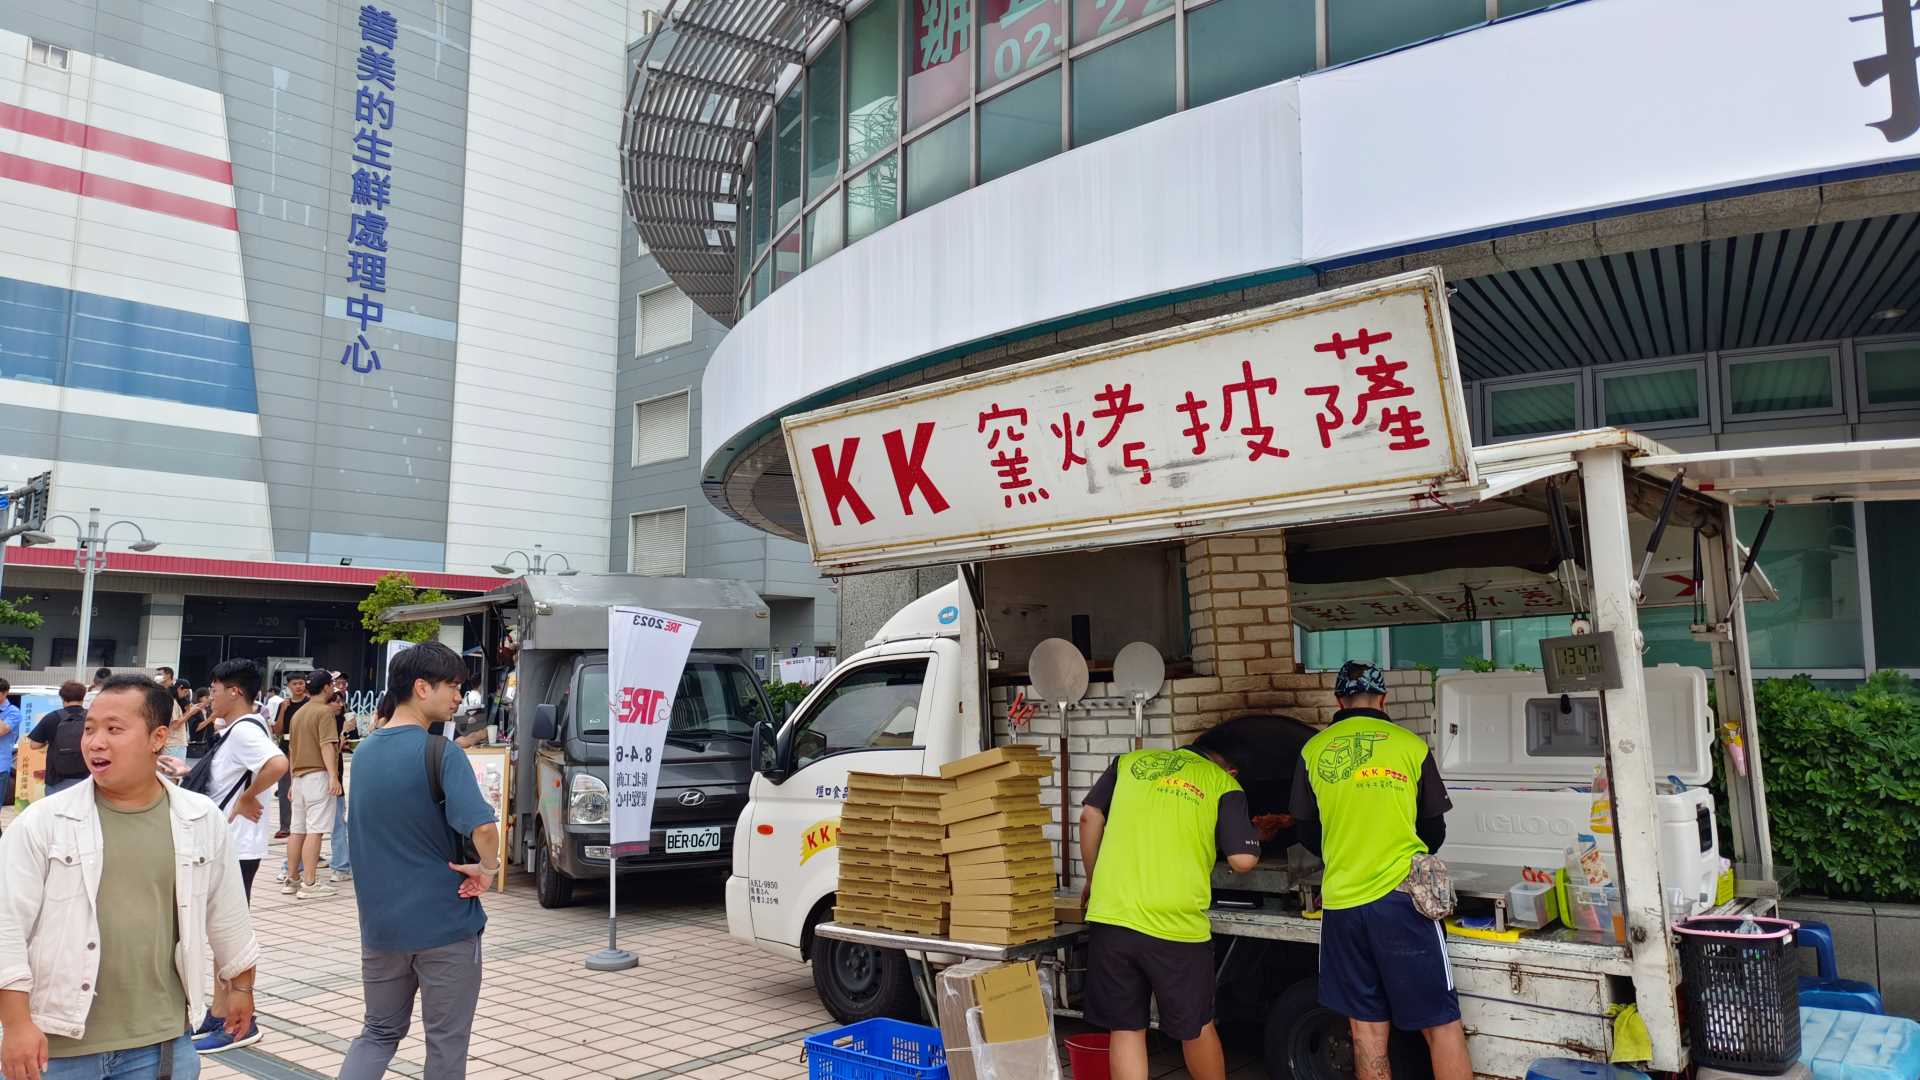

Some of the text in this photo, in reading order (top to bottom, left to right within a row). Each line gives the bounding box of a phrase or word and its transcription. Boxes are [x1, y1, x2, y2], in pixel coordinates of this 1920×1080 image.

[340, 5, 398, 374] 善美的生鮮處理中心
[977, 329, 1430, 509] 窯烤披薩
[1475, 811, 1575, 836] IGLOO
